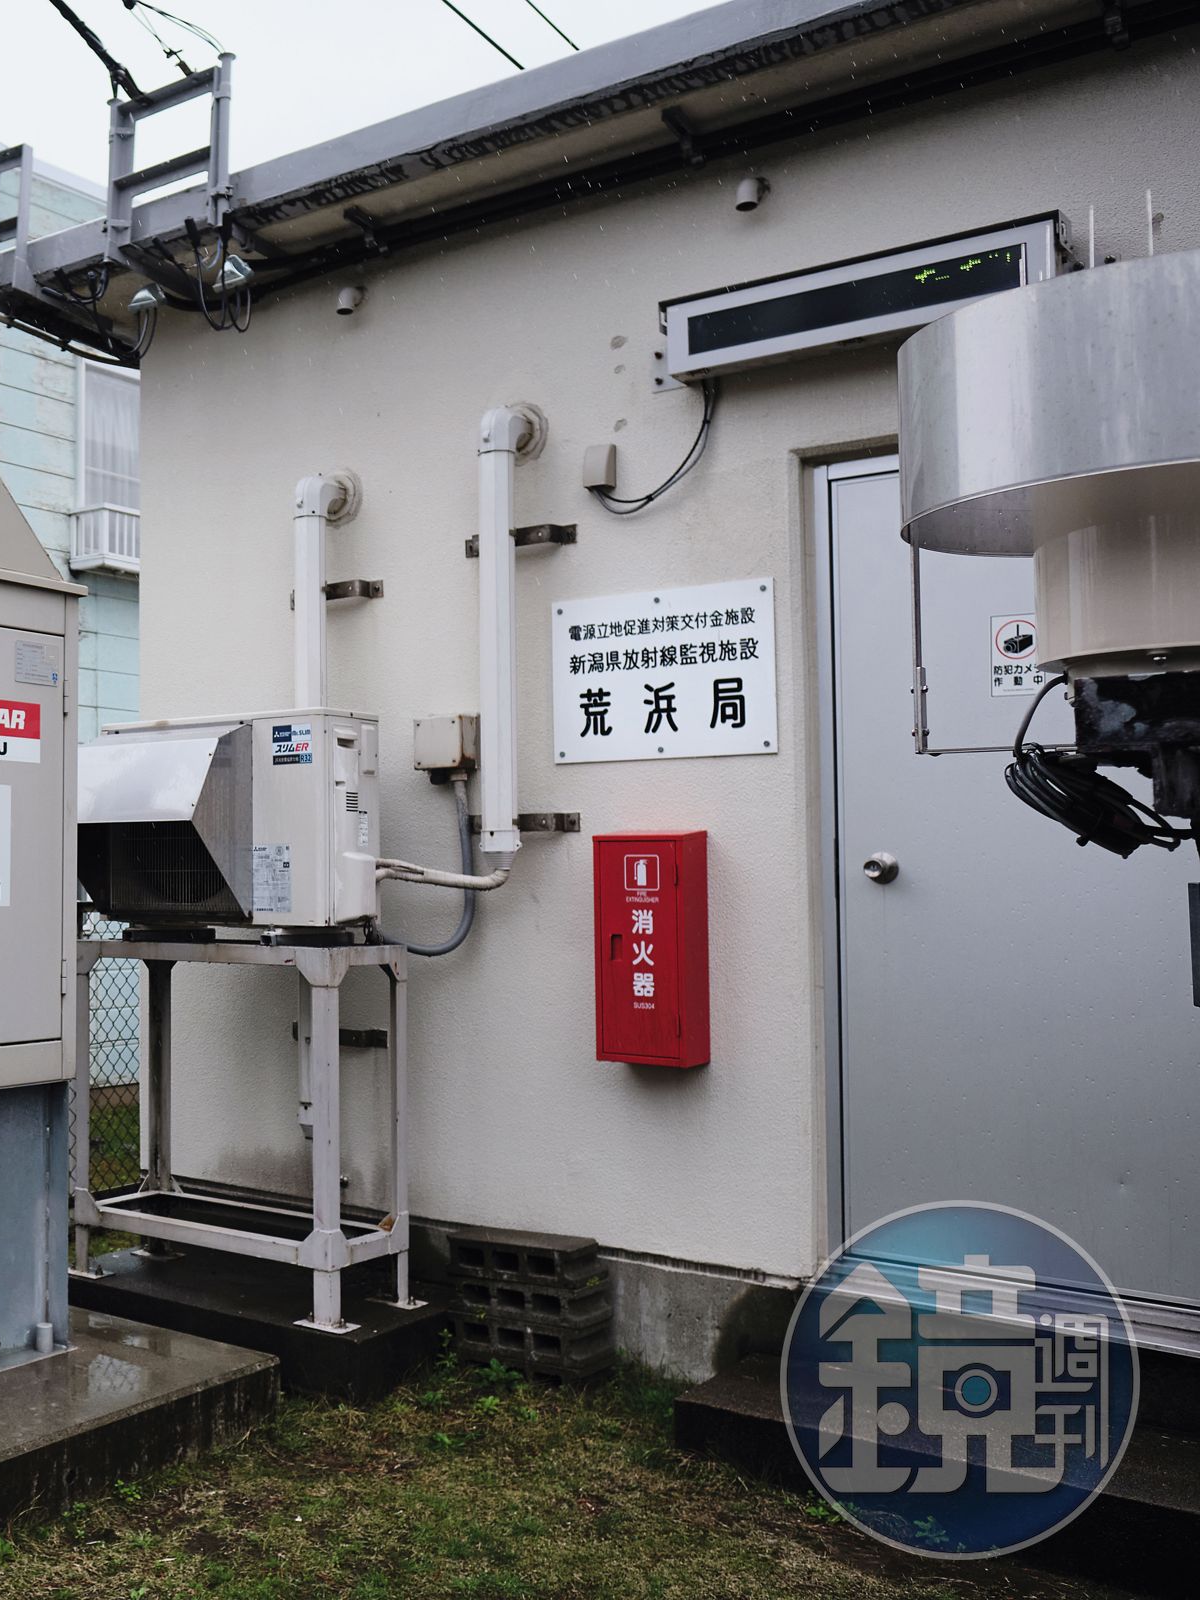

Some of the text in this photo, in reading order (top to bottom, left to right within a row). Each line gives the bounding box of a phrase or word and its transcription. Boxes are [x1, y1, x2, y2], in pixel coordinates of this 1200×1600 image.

[568, 607, 756, 642] 電源立地促進対策交付金施設
[569, 637, 760, 675] 新潟県放射線監視施設
[579, 677, 746, 737] 荒浜局
[631, 908, 655, 997] 消火器
